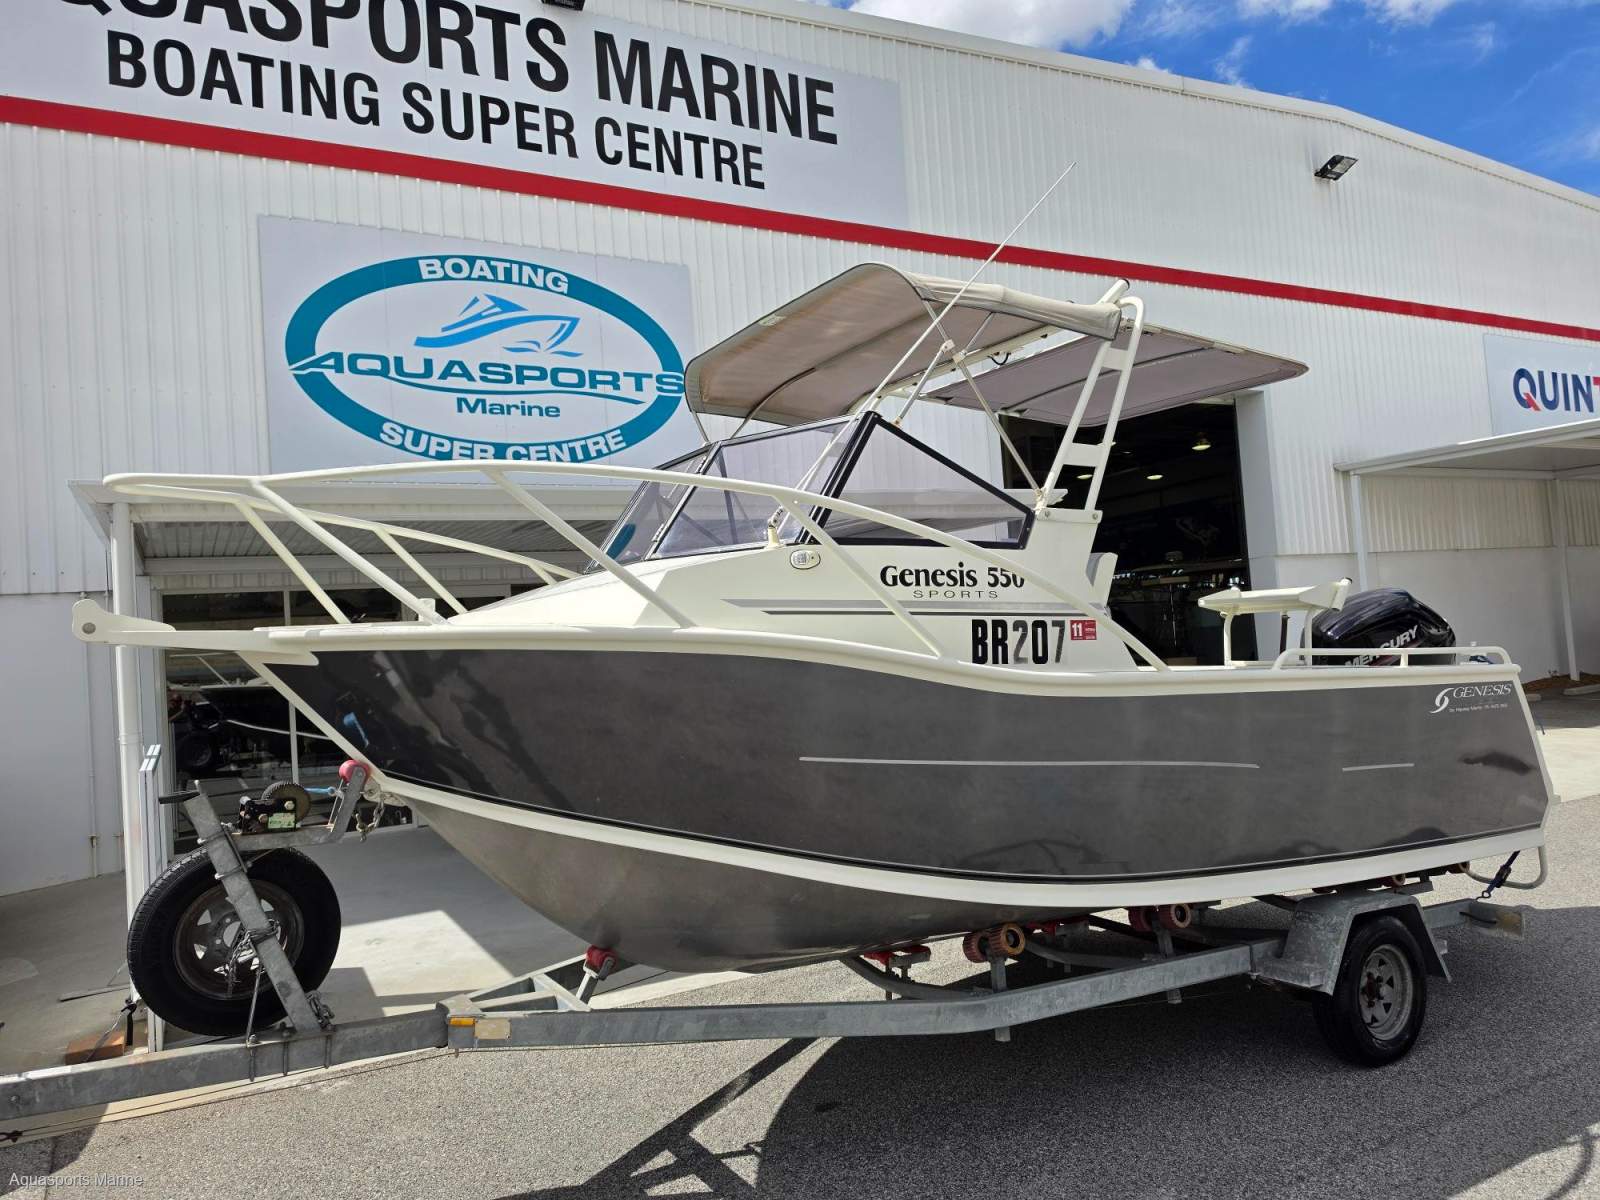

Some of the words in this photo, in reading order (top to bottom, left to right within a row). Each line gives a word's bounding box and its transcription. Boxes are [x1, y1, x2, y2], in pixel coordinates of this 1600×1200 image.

[60, 0, 569, 93] SPORTS
[594, 30, 838, 145] MARINE
[107, 29, 380, 127] BOATING
[402, 81, 579, 159] SUPER
[594, 116, 765, 190] CENTRE
[418, 257, 569, 294] BOATING
[289, 351, 684, 395] AQUASPORTS
[456, 397, 560, 418] Marine
[380, 421, 495, 460] SUPER
[505, 429, 627, 463] CENTRE
[880, 561, 978, 587] Genesis
[987, 566, 1025, 588] 550
[912, 589, 999, 599] SPORTS
[972, 619, 1065, 665] BR207
[1072, 622, 1083, 637] 11
[1344, 624, 1418, 667] MEURY
[1453, 683, 1512, 699] GENESIS
